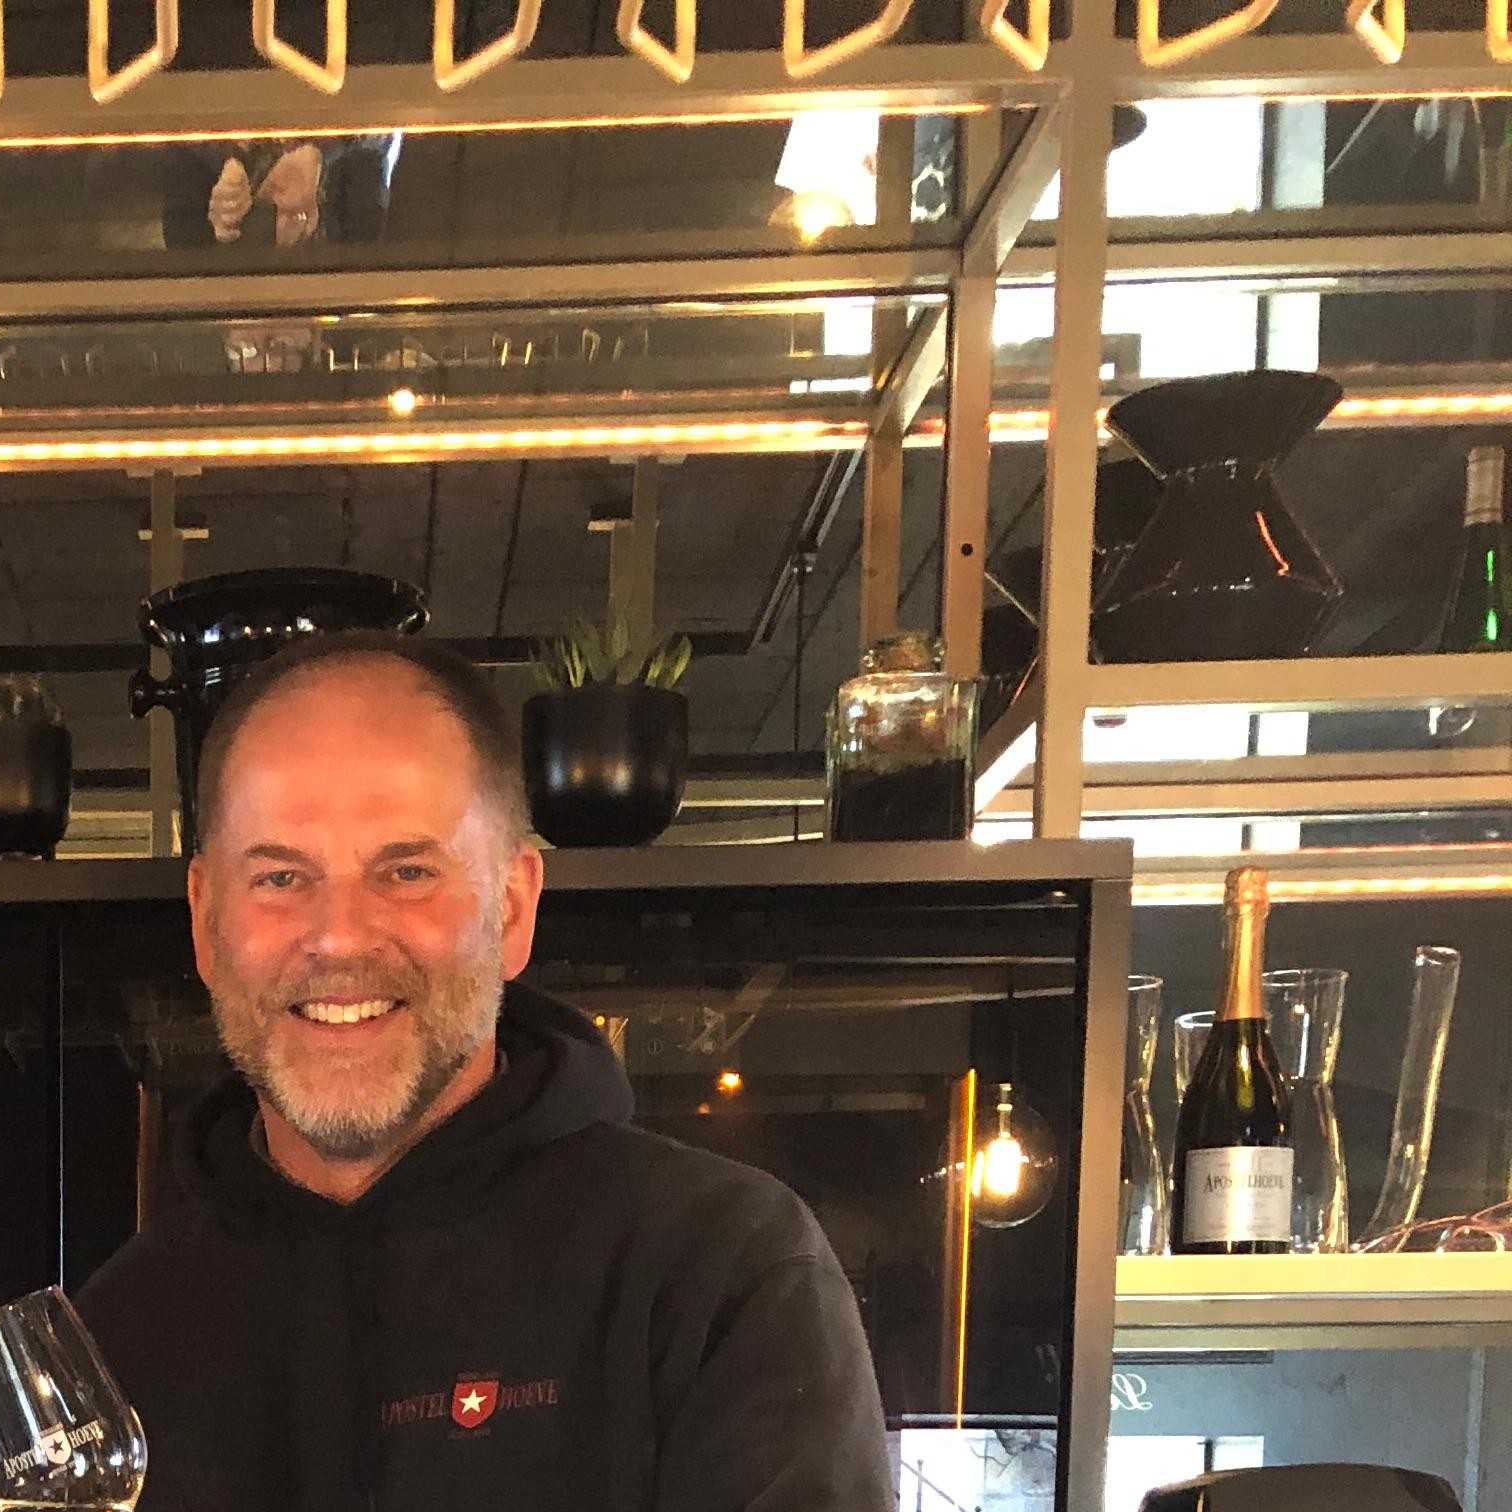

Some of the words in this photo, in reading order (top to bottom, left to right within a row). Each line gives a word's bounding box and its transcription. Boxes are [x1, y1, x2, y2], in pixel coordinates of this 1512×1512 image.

[1203, 1172, 1284, 1194] APOSLHOEVE
[3, 1447, 44, 1480] APOST
[67, 1418, 105, 1449] HOEVE
